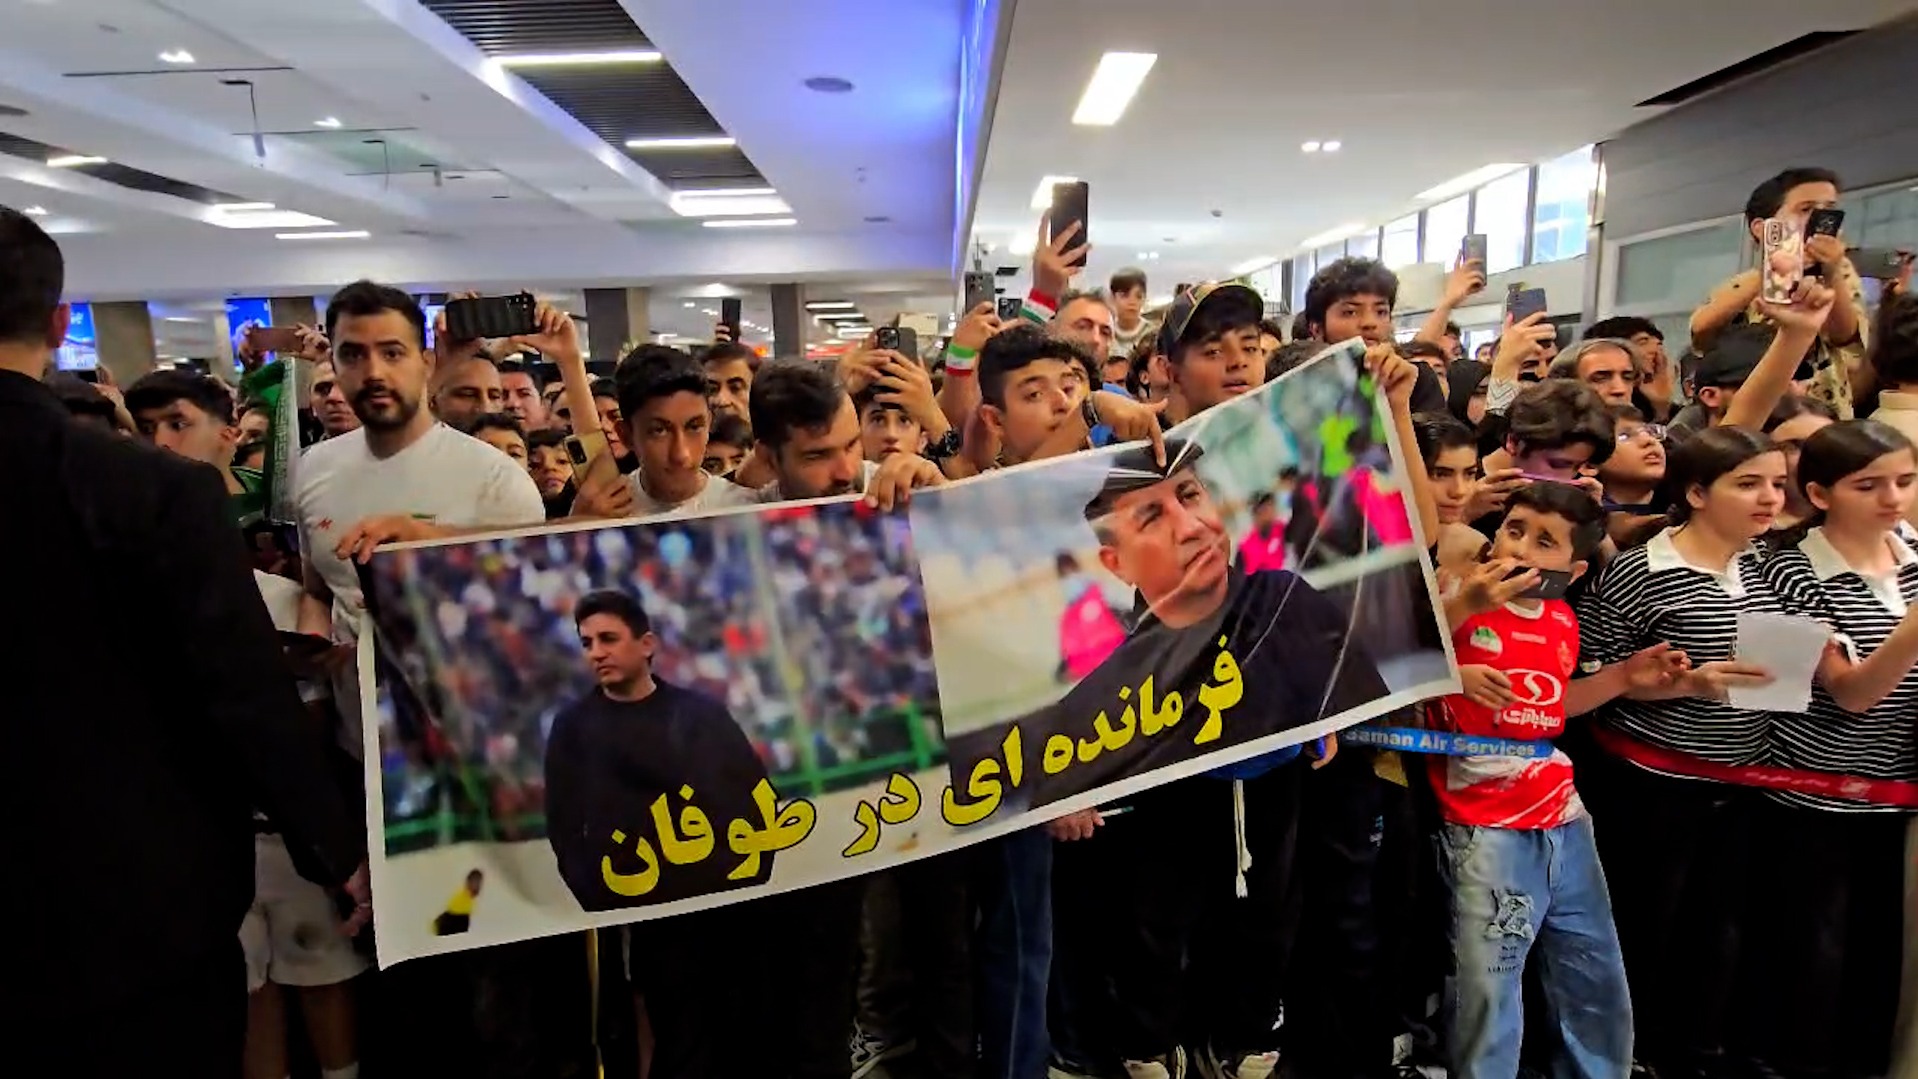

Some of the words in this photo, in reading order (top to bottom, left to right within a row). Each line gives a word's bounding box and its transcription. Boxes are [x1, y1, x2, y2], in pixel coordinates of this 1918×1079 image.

[1042, 634, 1244, 774] فرمانده
[1420, 734, 1449, 750] Air
[1453, 737, 1535, 756] Services
[842, 773, 922, 857] در
[941, 725, 1022, 825] ای
[599, 778, 817, 896] طوفان
